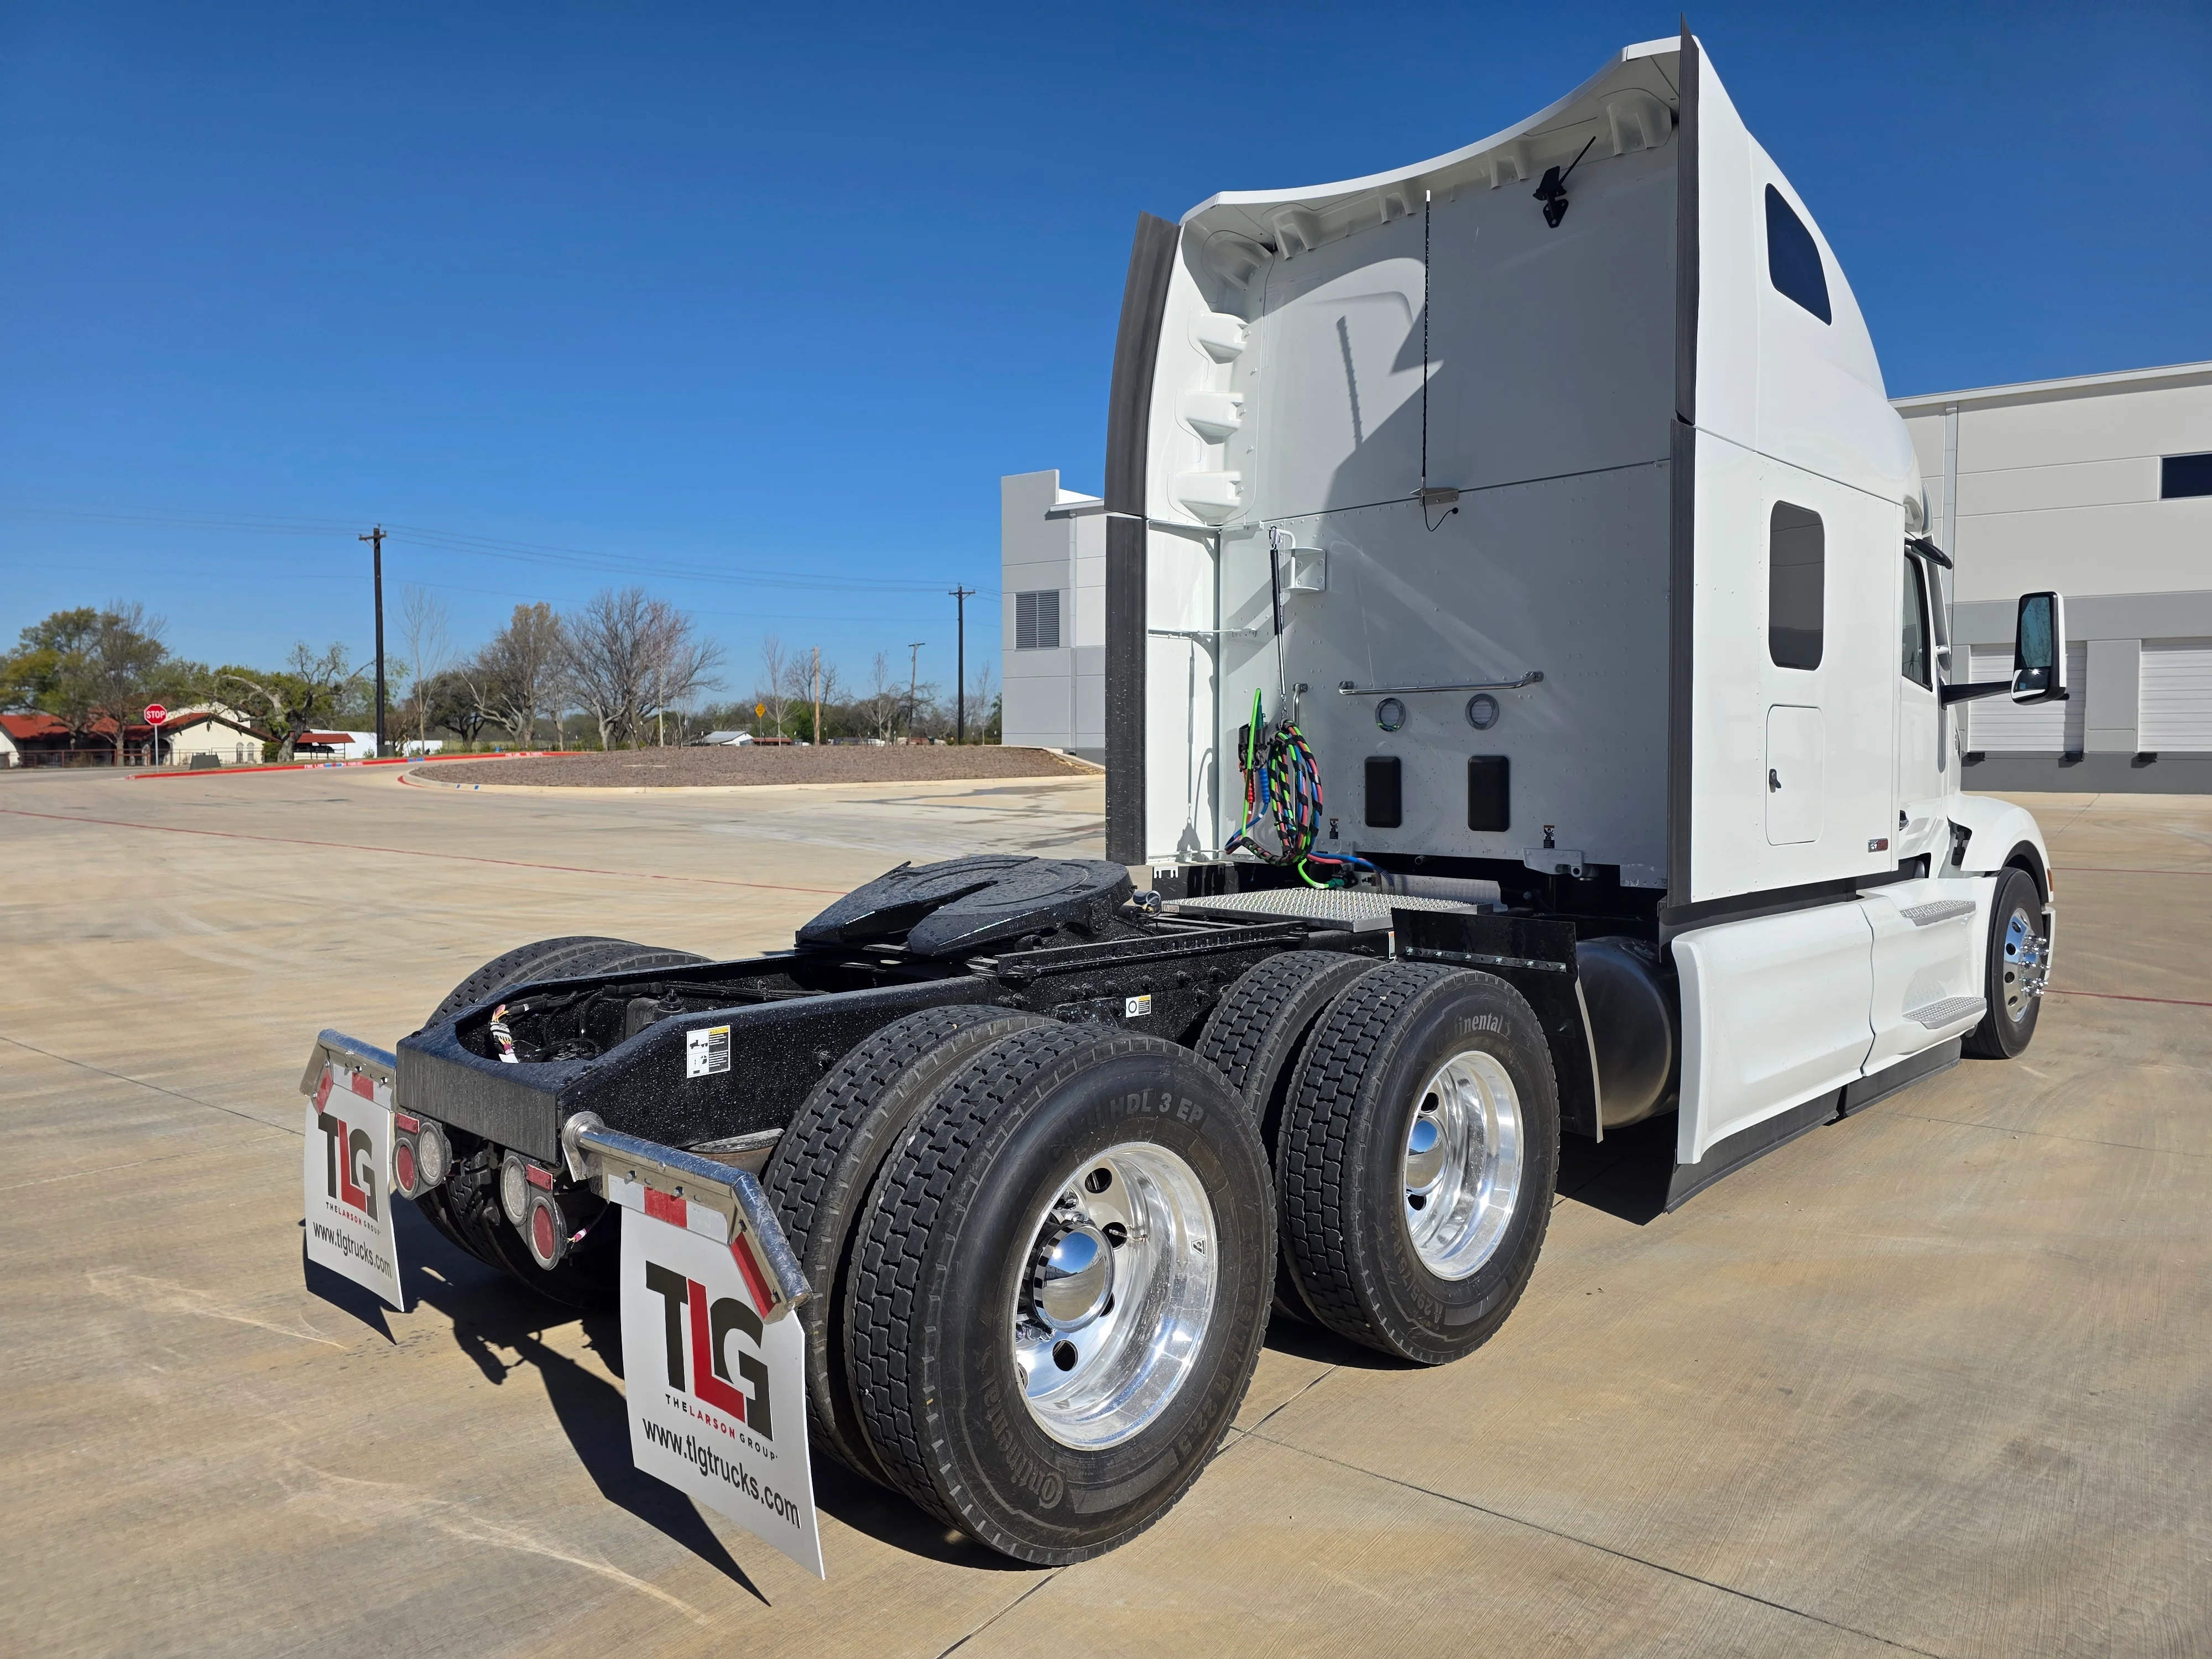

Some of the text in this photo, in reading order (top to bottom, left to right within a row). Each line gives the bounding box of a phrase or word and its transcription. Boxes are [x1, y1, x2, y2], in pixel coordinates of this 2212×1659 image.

[146, 710, 165, 719] STOP
[1436, 1013, 1504, 1057] Cotinental
[1110, 1092, 1151, 1118] HDL
[1159, 1093, 1172, 1113] 3
[1176, 1098, 1204, 1124] EP
[318, 1112, 378, 1222] TLG
[313, 1222, 392, 1279] www.tlgtrucks.com
[363, 1220, 380, 1236] GROUP
[646, 1260, 773, 1442] TLG
[739, 1433, 775, 1460] GROUP
[978, 1373, 1064, 1509] Continental
[642, 1418, 801, 1529] www.tlgtrucks.com
